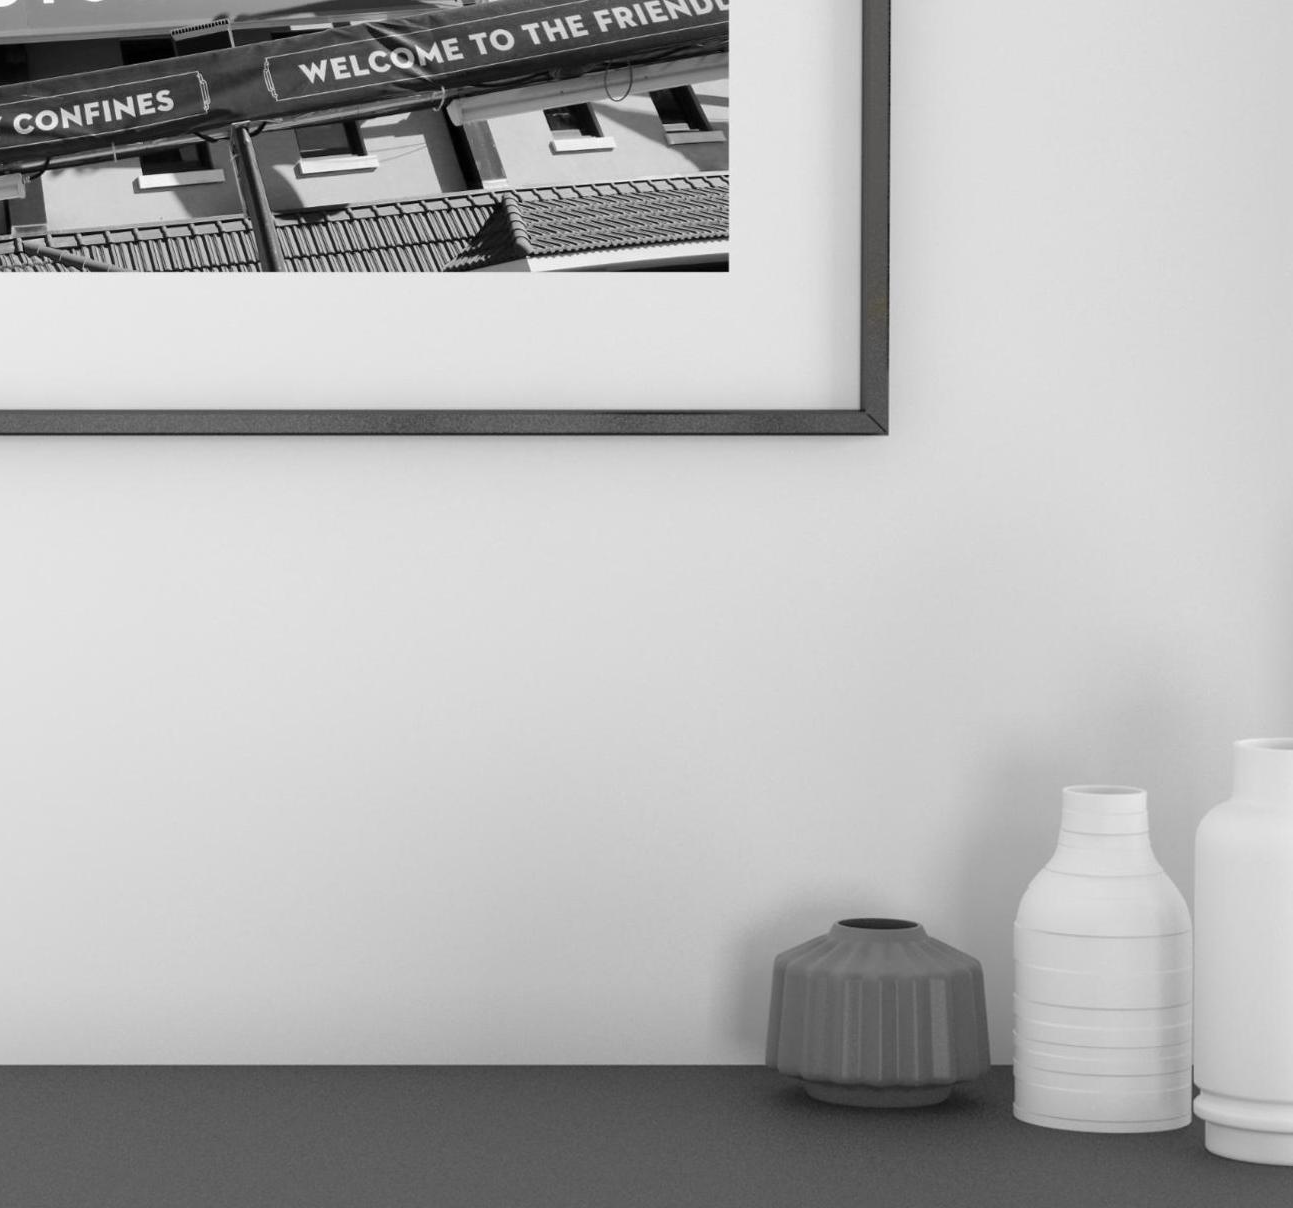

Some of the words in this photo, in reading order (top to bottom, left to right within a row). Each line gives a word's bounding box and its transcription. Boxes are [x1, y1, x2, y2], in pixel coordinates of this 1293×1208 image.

[298, 36, 465, 84] WELCOME
[469, 28, 515, 55] TO
[521, 13, 589, 46] THE
[13, 89, 175, 135] CONFINES
